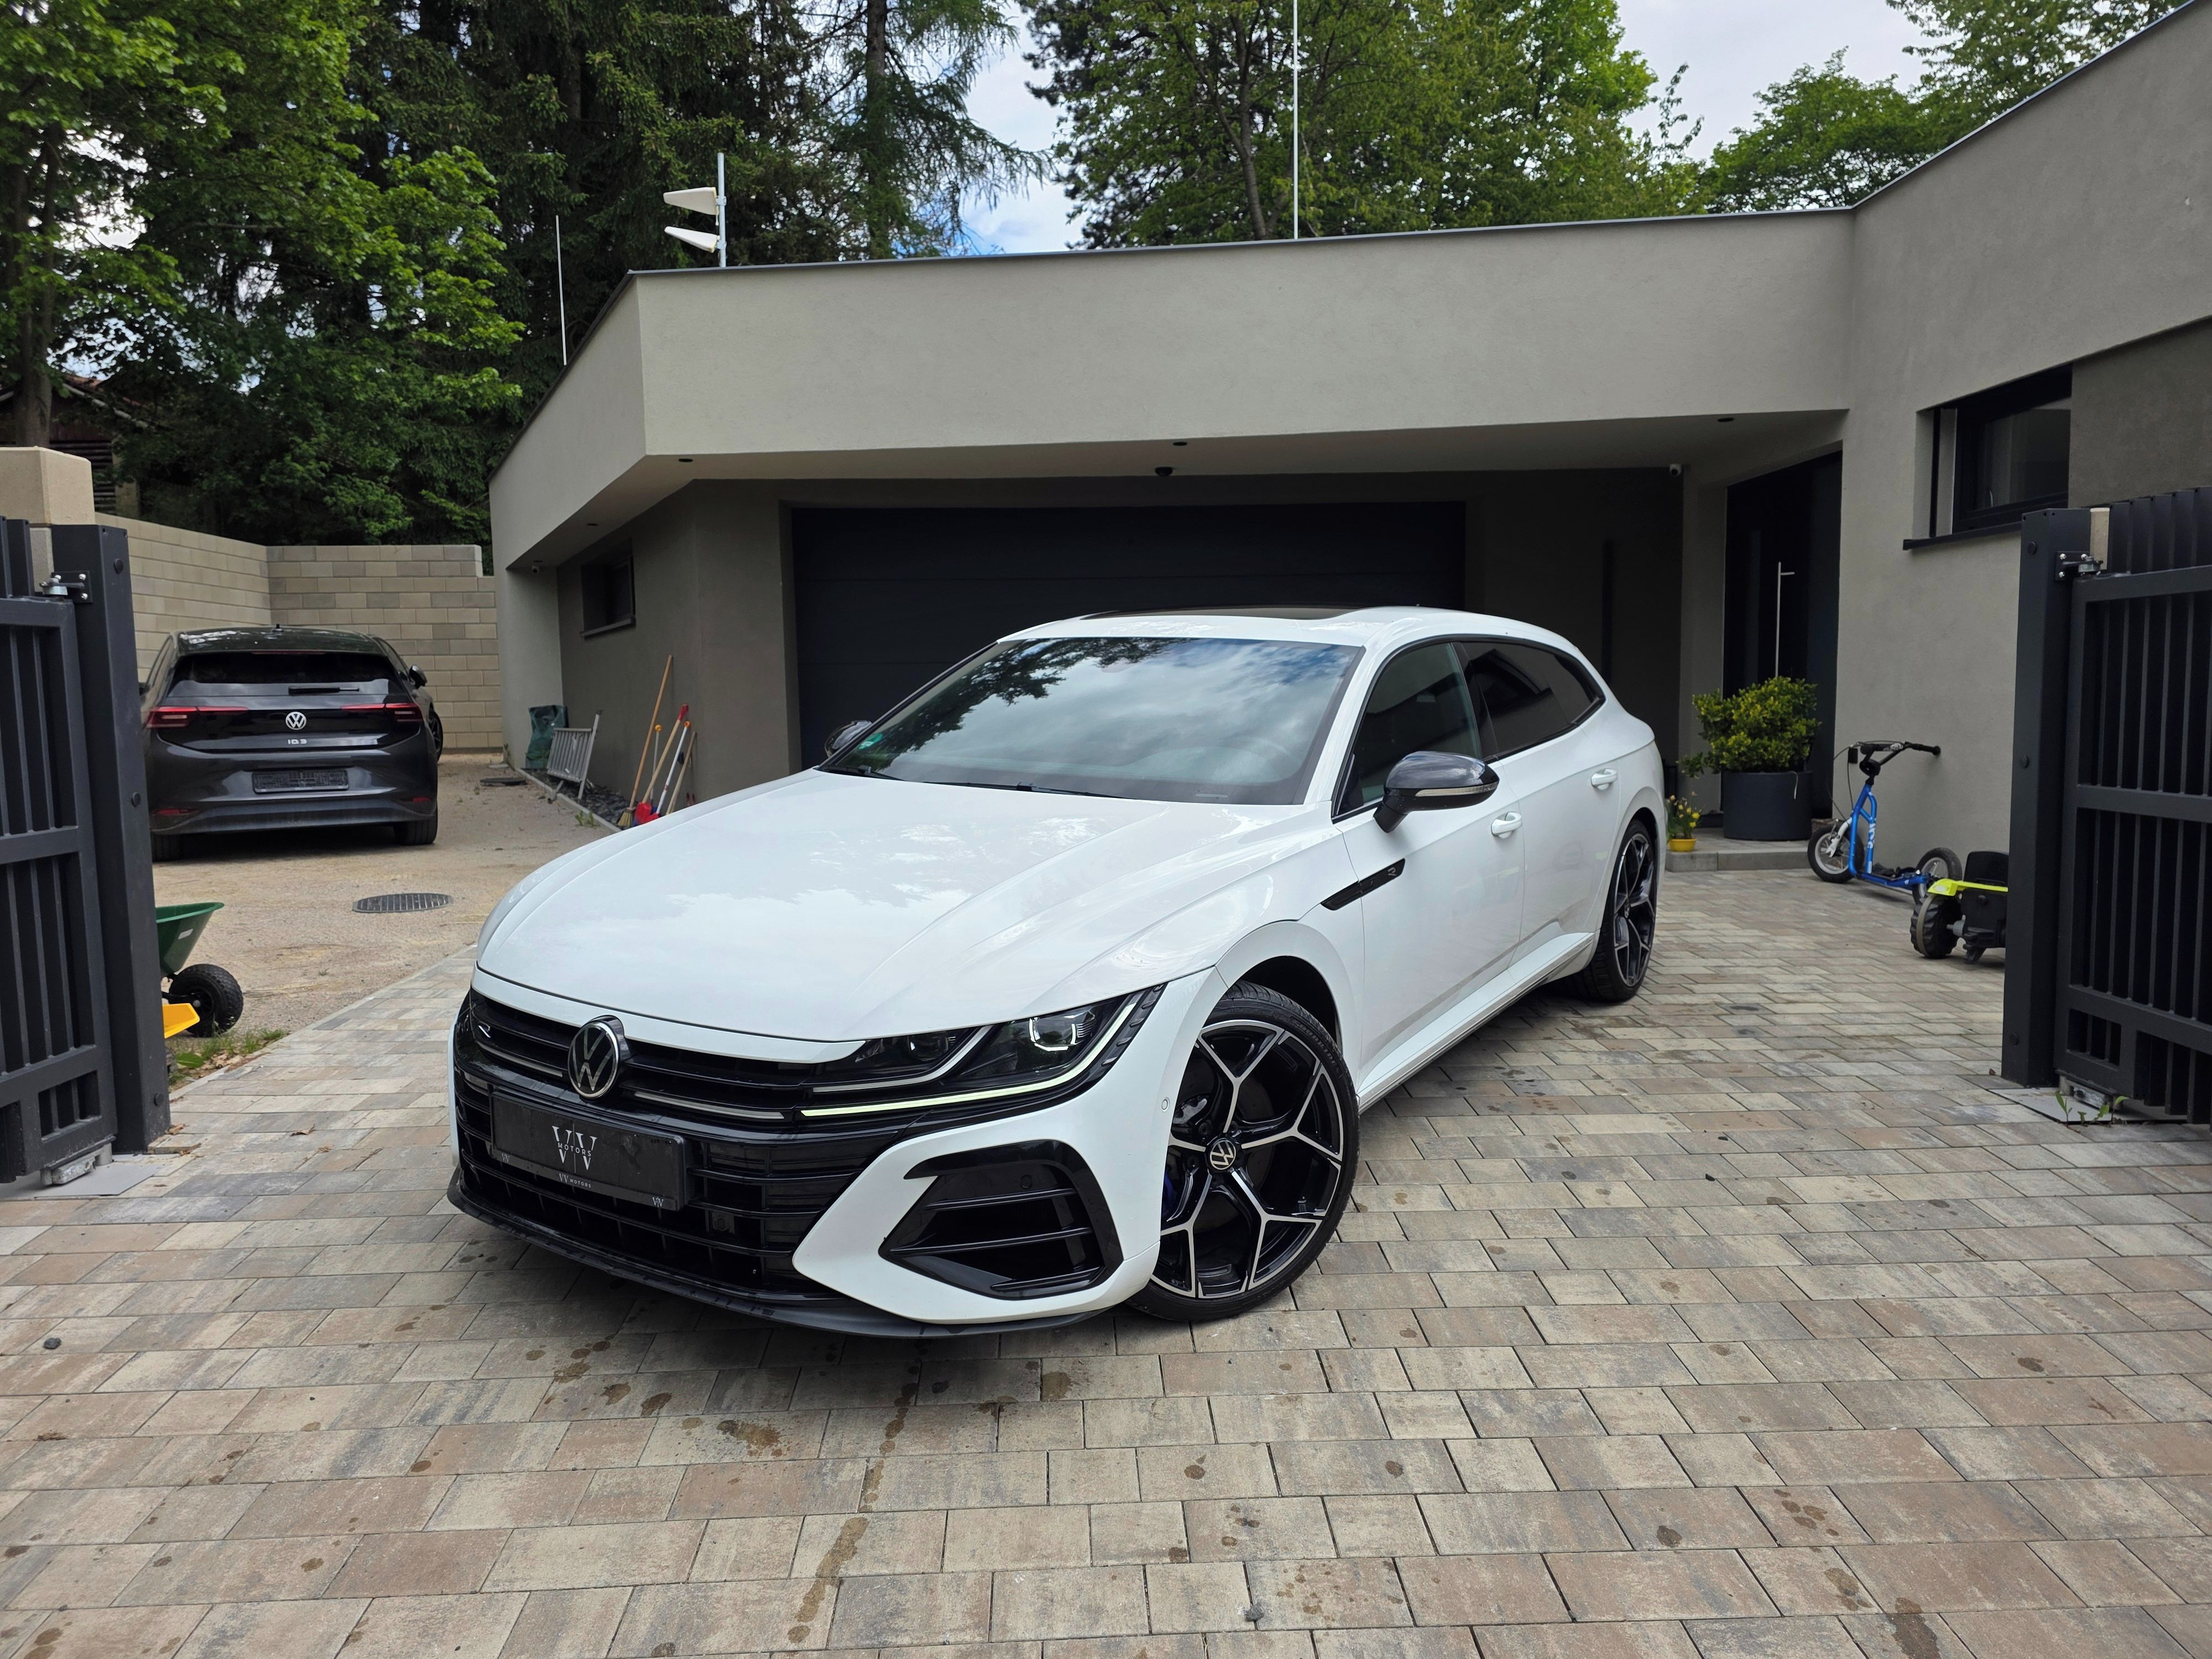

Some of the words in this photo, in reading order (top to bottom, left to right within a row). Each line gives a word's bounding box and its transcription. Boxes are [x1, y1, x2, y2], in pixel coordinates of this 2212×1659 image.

[571, 1024, 616, 1093] VW
[557, 1142, 592, 1157] MOTORS
[570, 1178, 591, 1188] MOTORS
